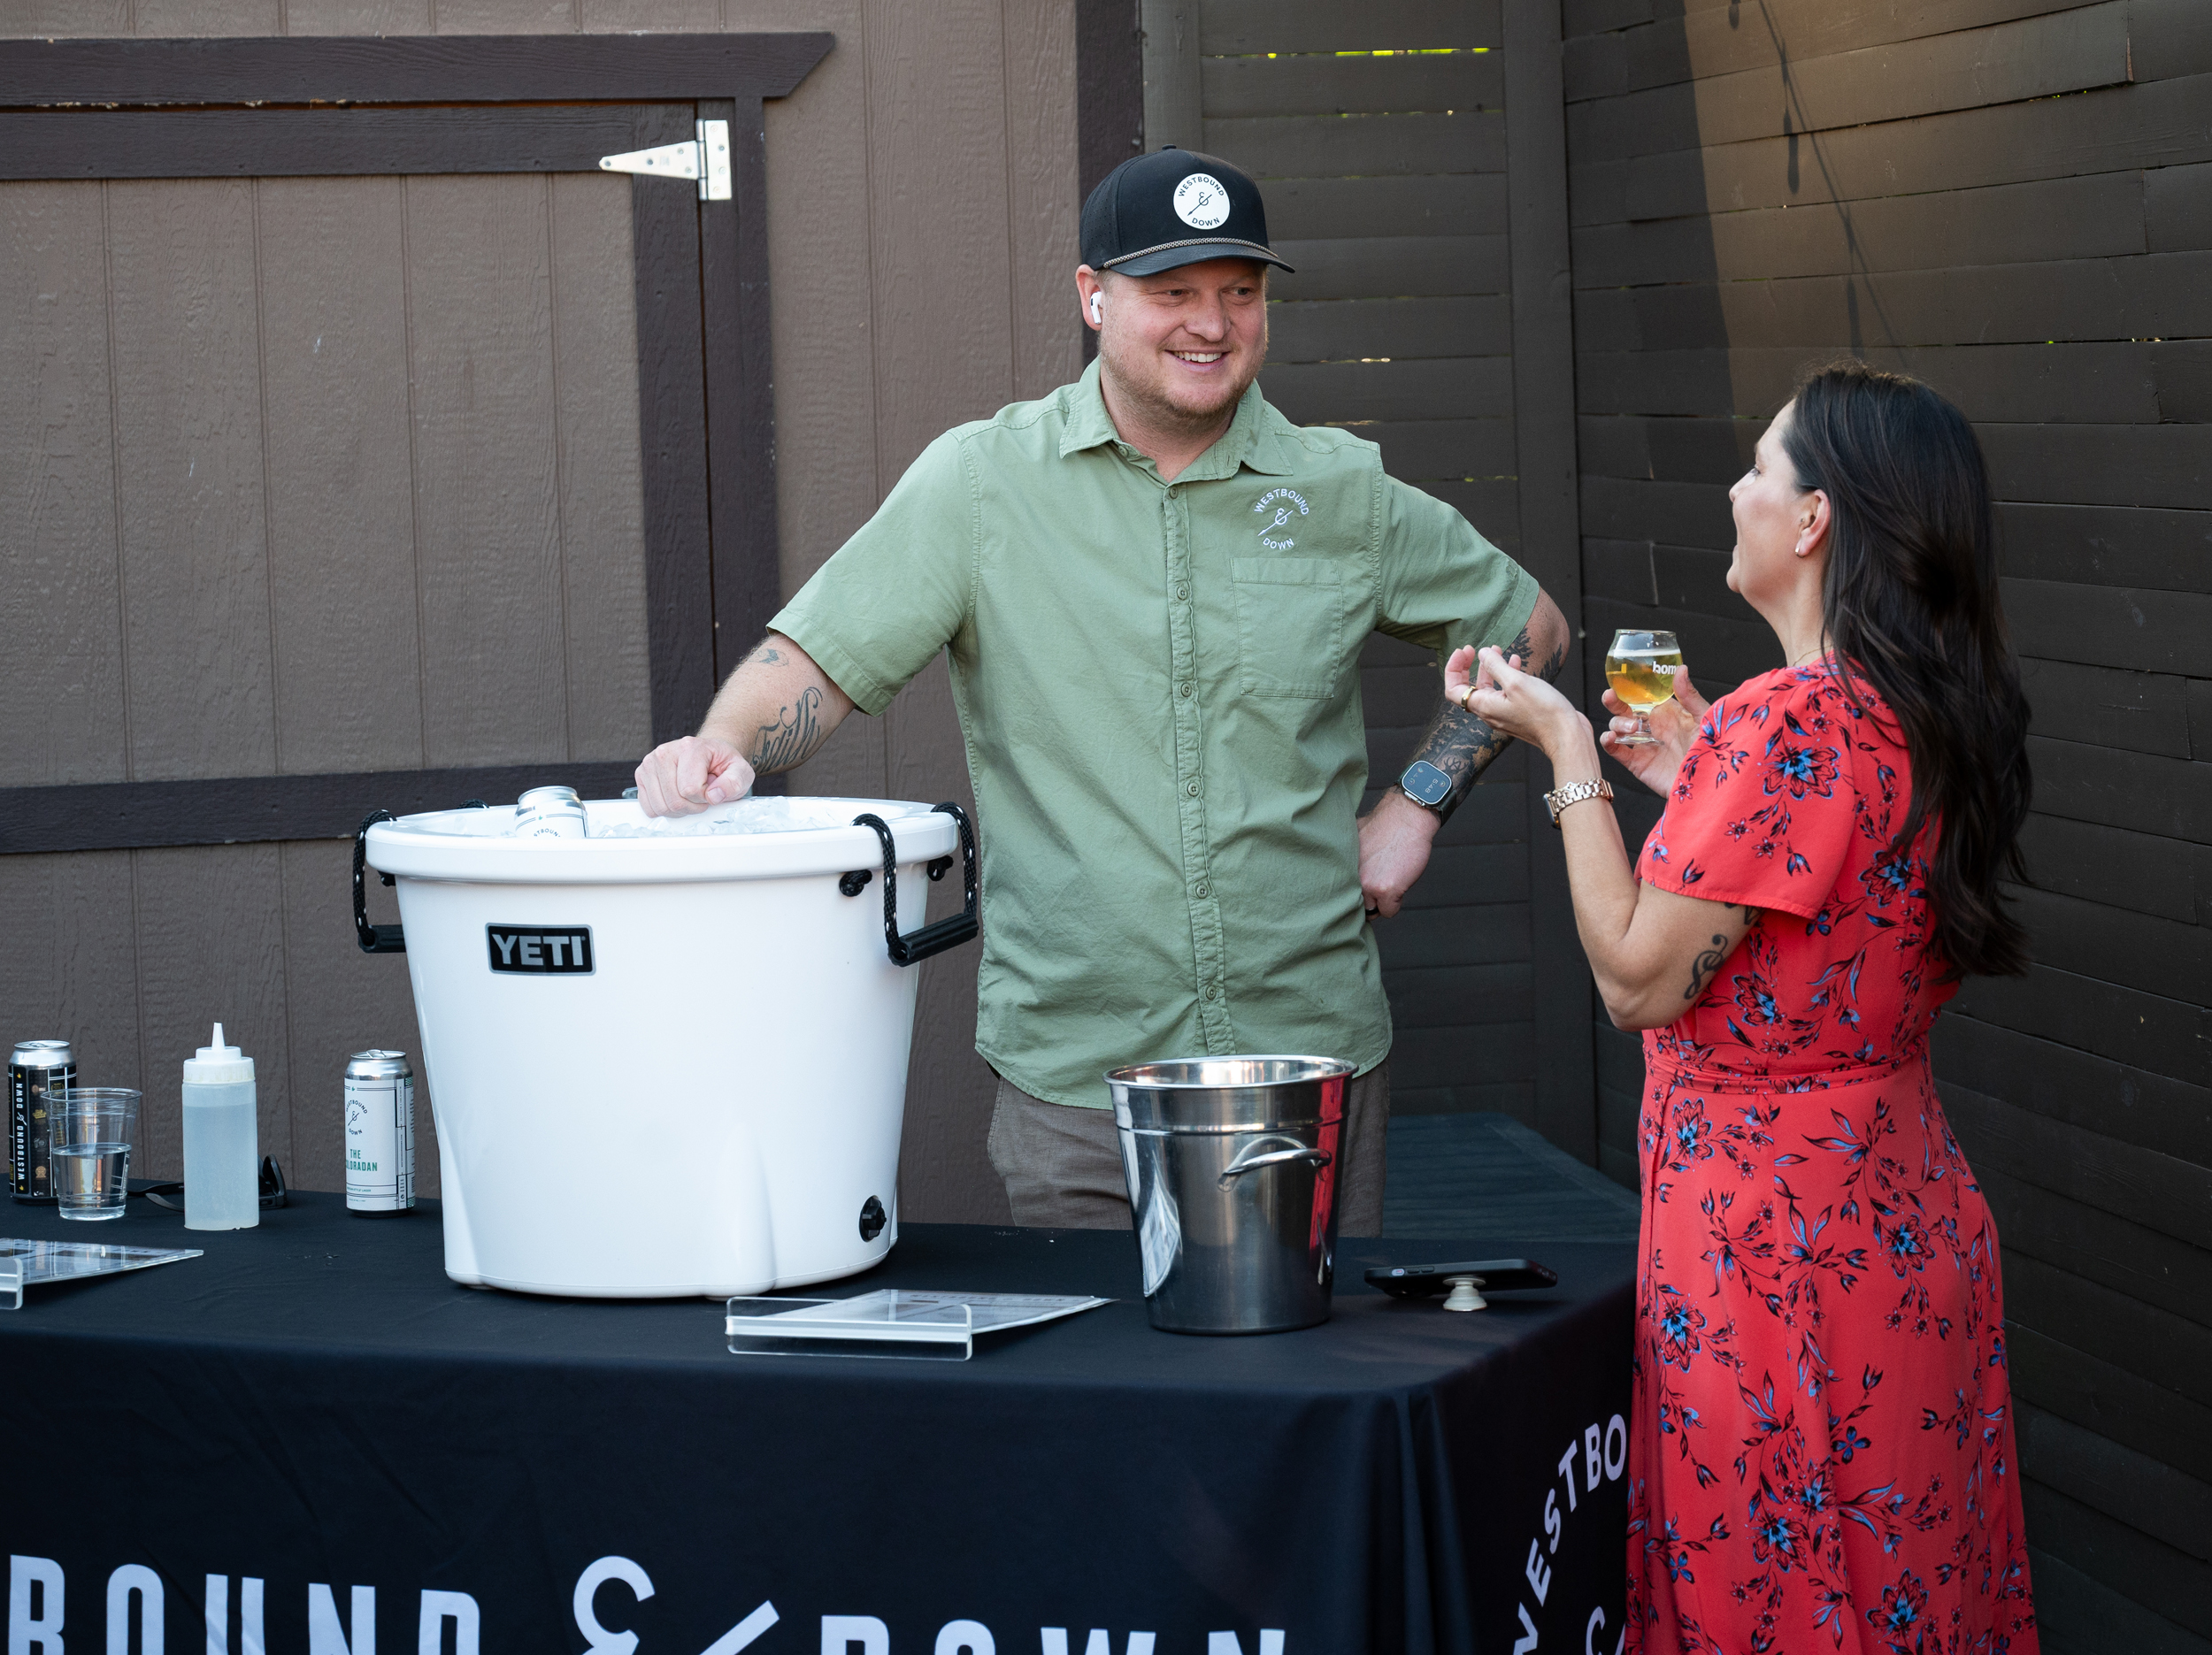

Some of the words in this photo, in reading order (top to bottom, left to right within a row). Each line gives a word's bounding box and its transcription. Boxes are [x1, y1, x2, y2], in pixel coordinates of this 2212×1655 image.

[1178, 176, 1225, 197] WESTBOUND
[1192, 218, 1220, 226] DOWN
[1254, 488, 1310, 515] WESTBOUND
[1263, 537, 1294, 550] DOWN
[1652, 660, 1679, 675] bom
[534, 828, 561, 838] STBOUN
[492, 933, 584, 966] YETI
[16, 1125, 25, 1180] WESTBOUND
[349, 1148, 361, 1160] THE
[346, 1159, 378, 1172] OLORADAN
[1513, 1414, 1627, 1655] ESTBO
